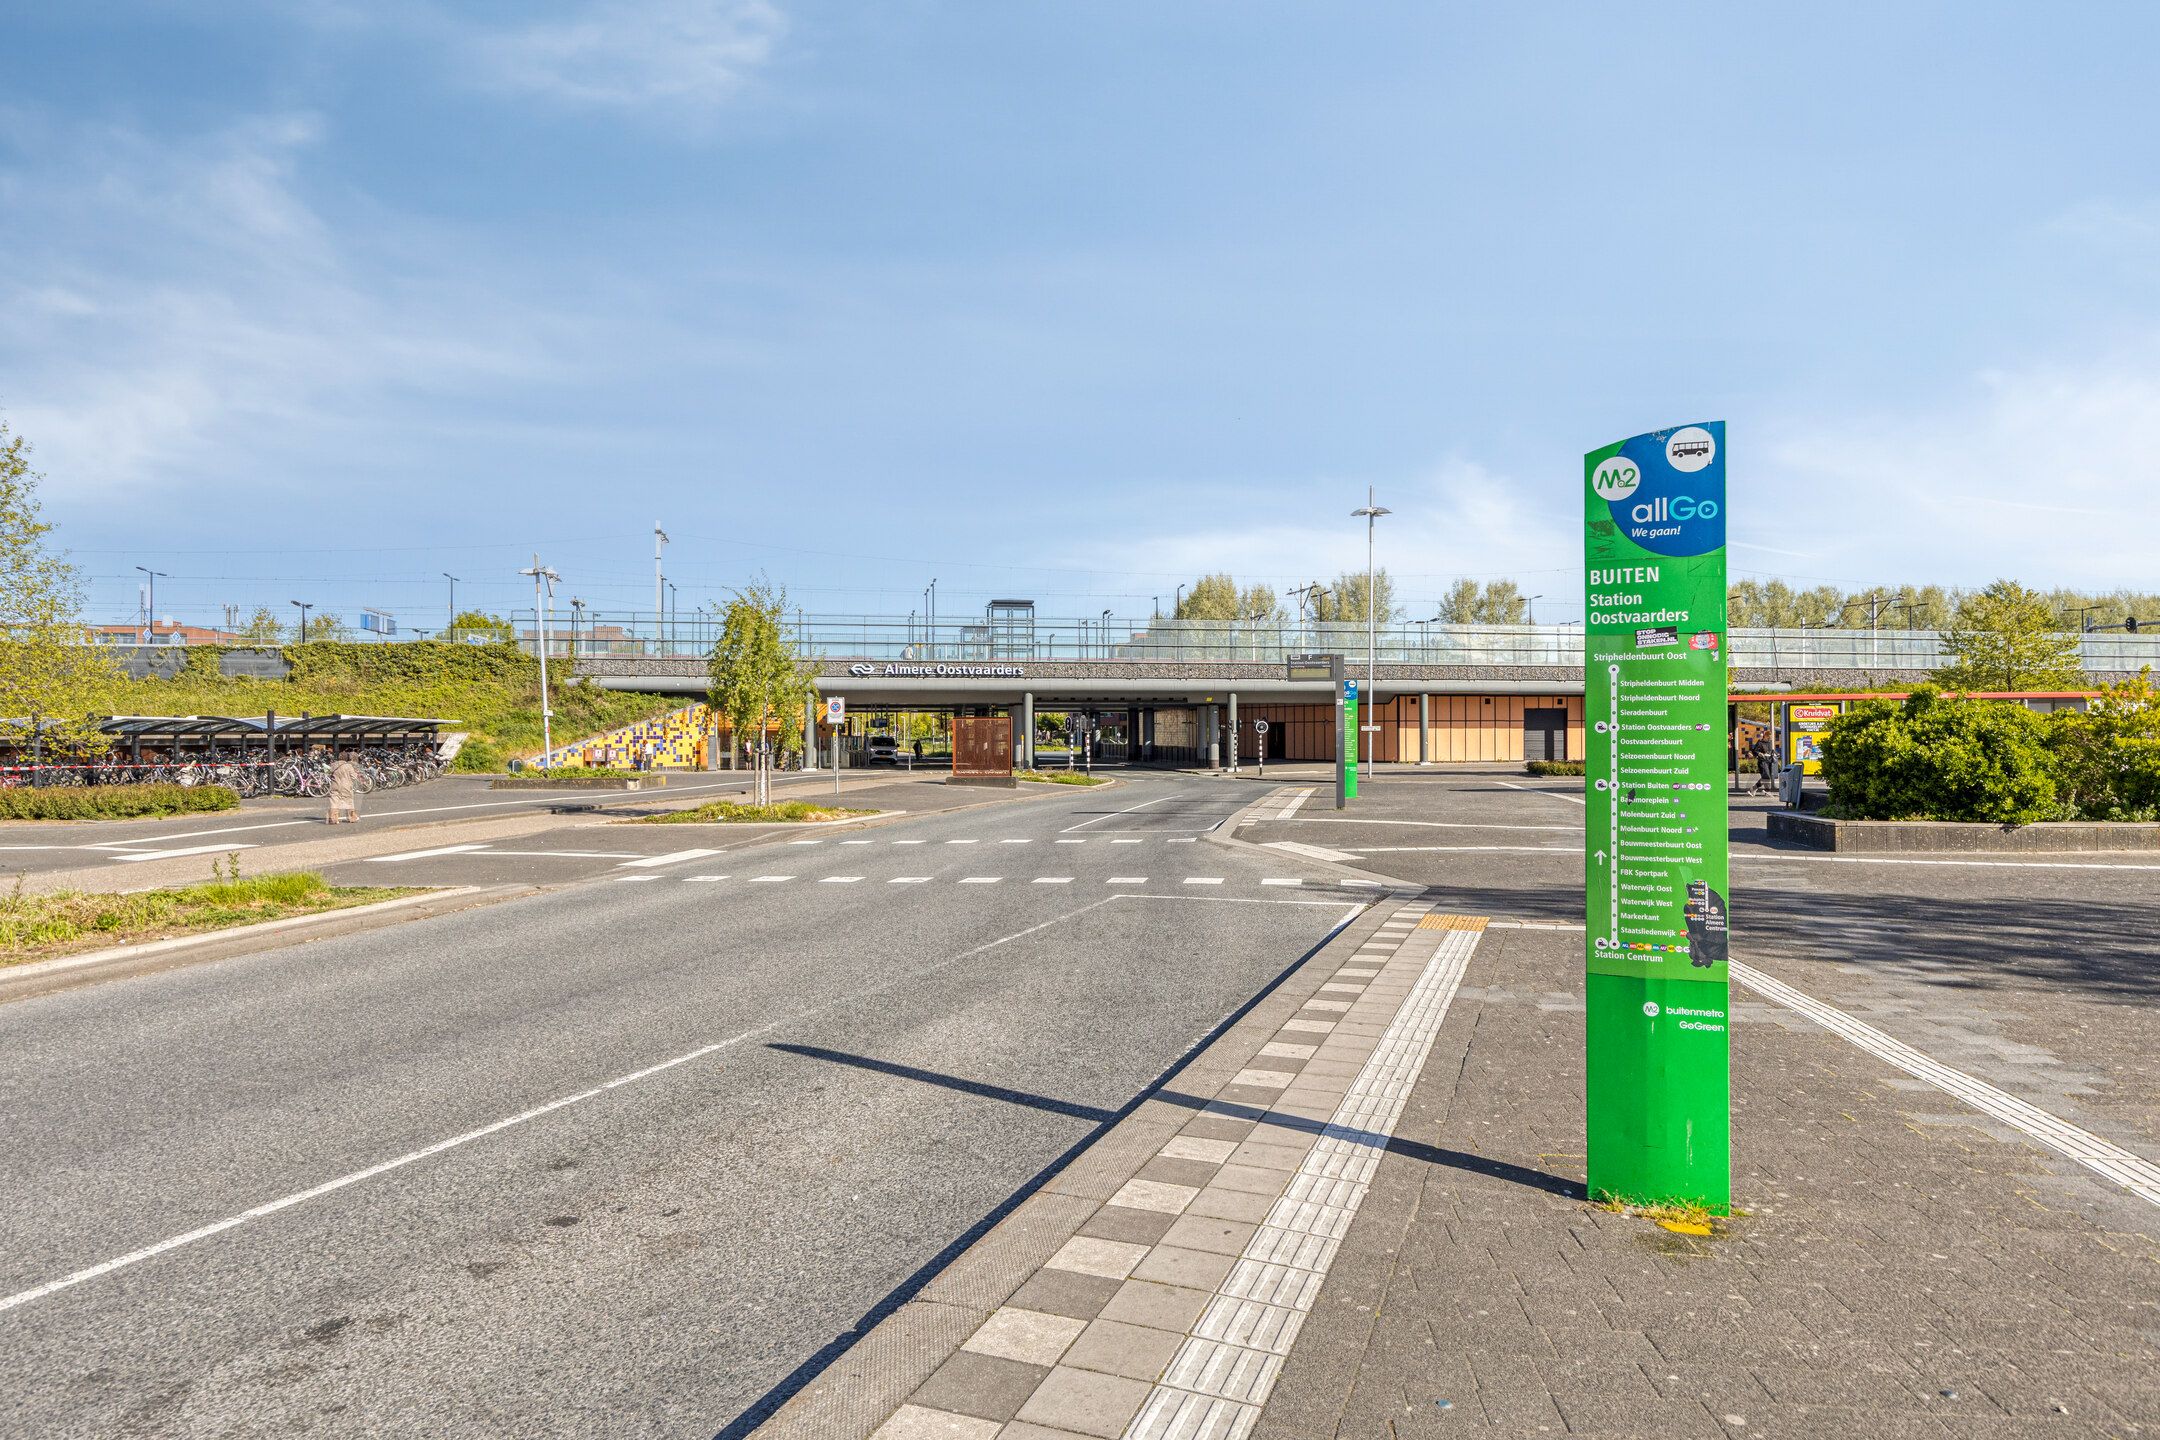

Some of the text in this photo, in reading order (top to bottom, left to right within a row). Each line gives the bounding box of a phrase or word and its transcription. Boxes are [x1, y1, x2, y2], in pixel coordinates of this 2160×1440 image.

[1631, 495, 1718, 524] allGo
[1631, 525, 1681, 539] We gaan!
[1590, 566, 1660, 586] BUITEN
[1590, 591, 1642, 607] Station
[1590, 607, 1689, 625] Oostvaarders
[1637, 637, 1677, 645] STAKEN.NL
[1594, 652, 1687, 662] Stripheldenbuurt Oost
[884, 664, 1024, 675] Almere Oostvaarders
[1620, 680, 1677, 688] Stripheldenbuurt
[1620, 695, 1677, 703] Stripheldenbuurt
[1647, 723, 1692, 731] Oostvaarders
[1620, 738, 1683, 746] Oostvaardersbuurt
[1620, 752, 1672, 760] Seizoenenbuurt
[1674, 767, 1689, 775] Zuid
[1620, 825, 1659, 833] Molenbuurt
[1620, 840, 1702, 849] Bouwmeesterbuurt Oost
[1620, 855, 1684, 863] Bouwmeesterbuurt
[1635, 870, 1668, 878] Sportpark
[1621, 884, 1654, 893] Waterwijk
[1621, 898, 1654, 907] Waterwijk
[1620, 913, 1659, 921] Markerkant
[1620, 927, 1676, 937] Staatsliedenwijk
[1594, 950, 1663, 963] Station Centrum
[1666, 1006, 1725, 1018] buitenmetro
[1679, 1020, 1725, 1031] GoGreen
